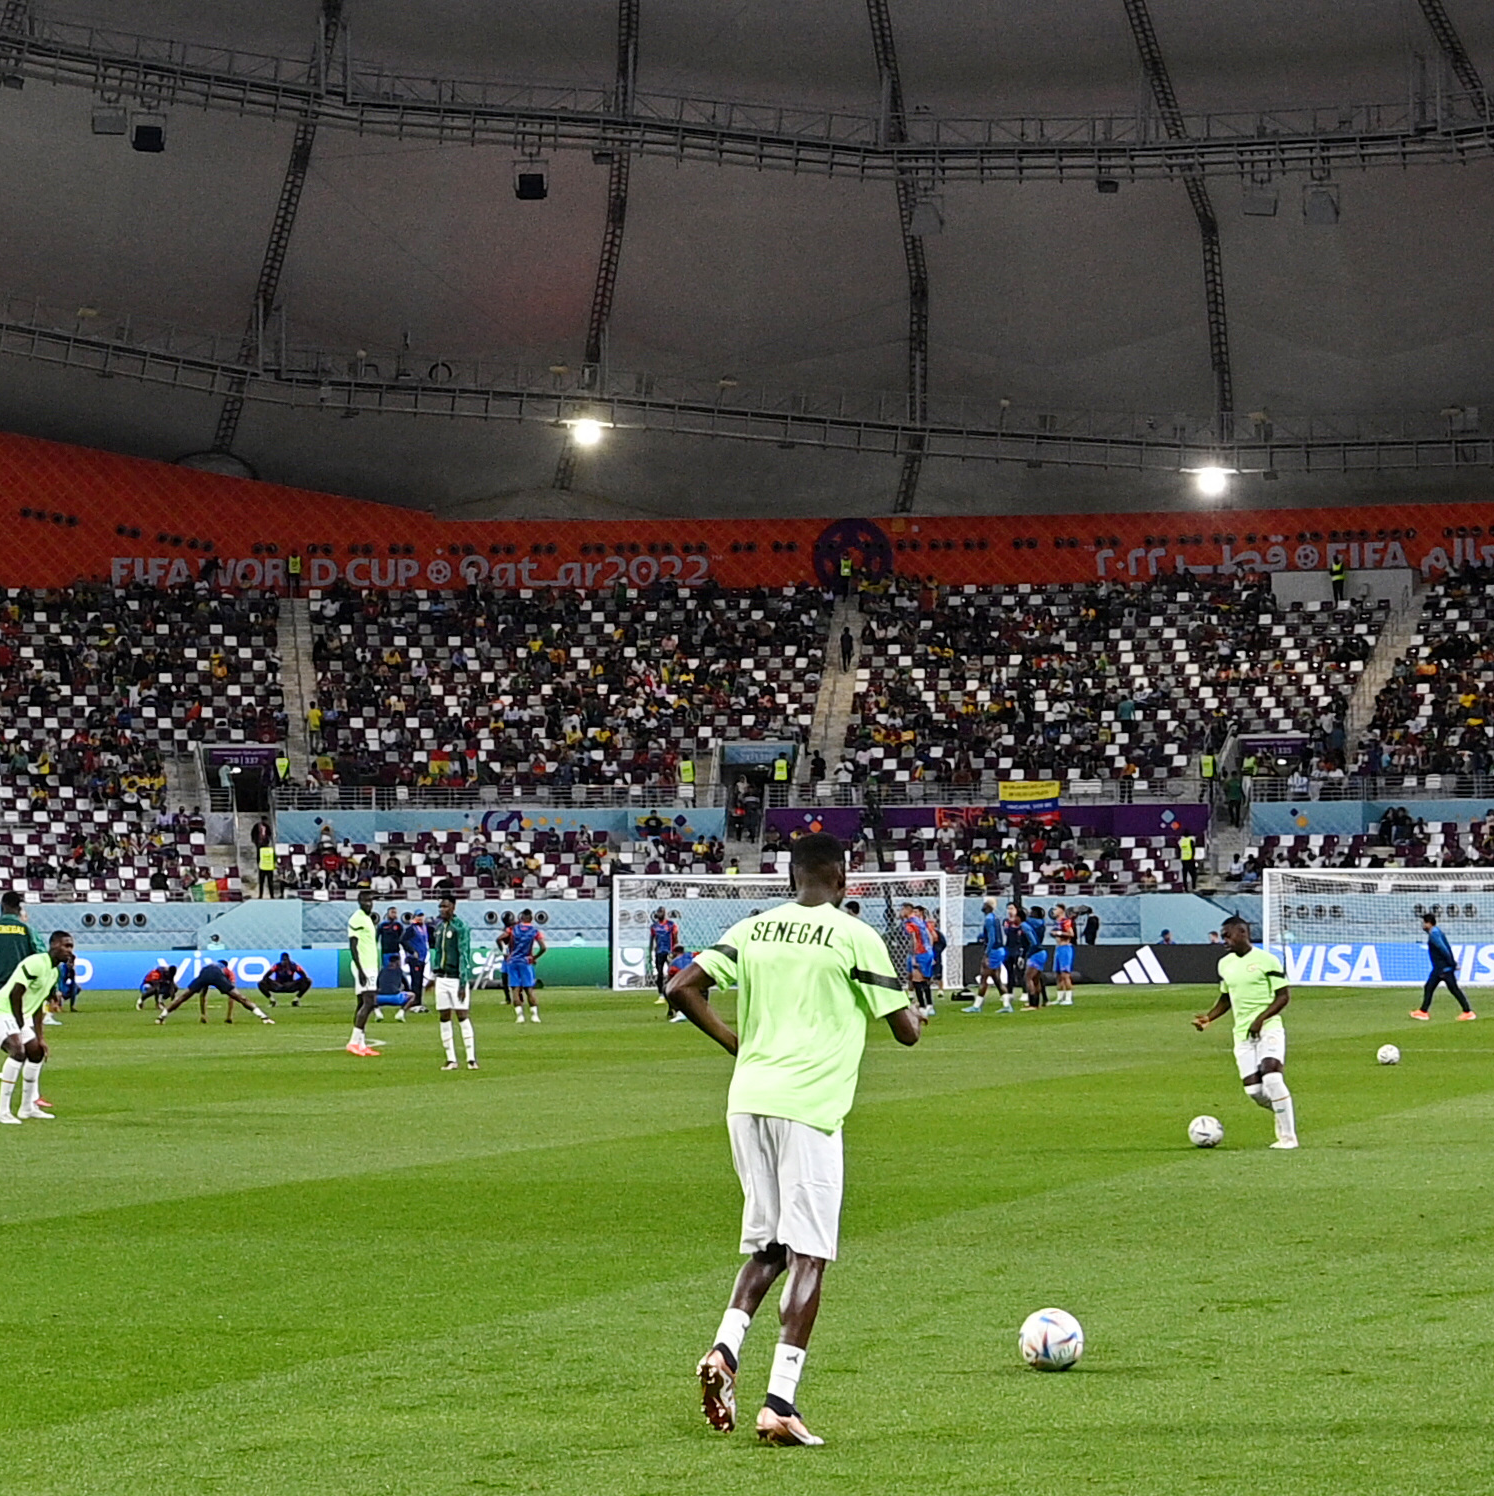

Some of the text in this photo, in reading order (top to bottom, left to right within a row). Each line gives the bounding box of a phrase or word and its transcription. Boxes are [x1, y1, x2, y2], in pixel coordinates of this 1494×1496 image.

[1326, 541, 1409, 570] FIFA
[111, 557, 189, 587] FIFA
[199, 557, 338, 587] WORD
[345, 558, 420, 587] CUP
[750, 921, 834, 948] SENEGAL
[1272, 944, 1382, 982] VISA
